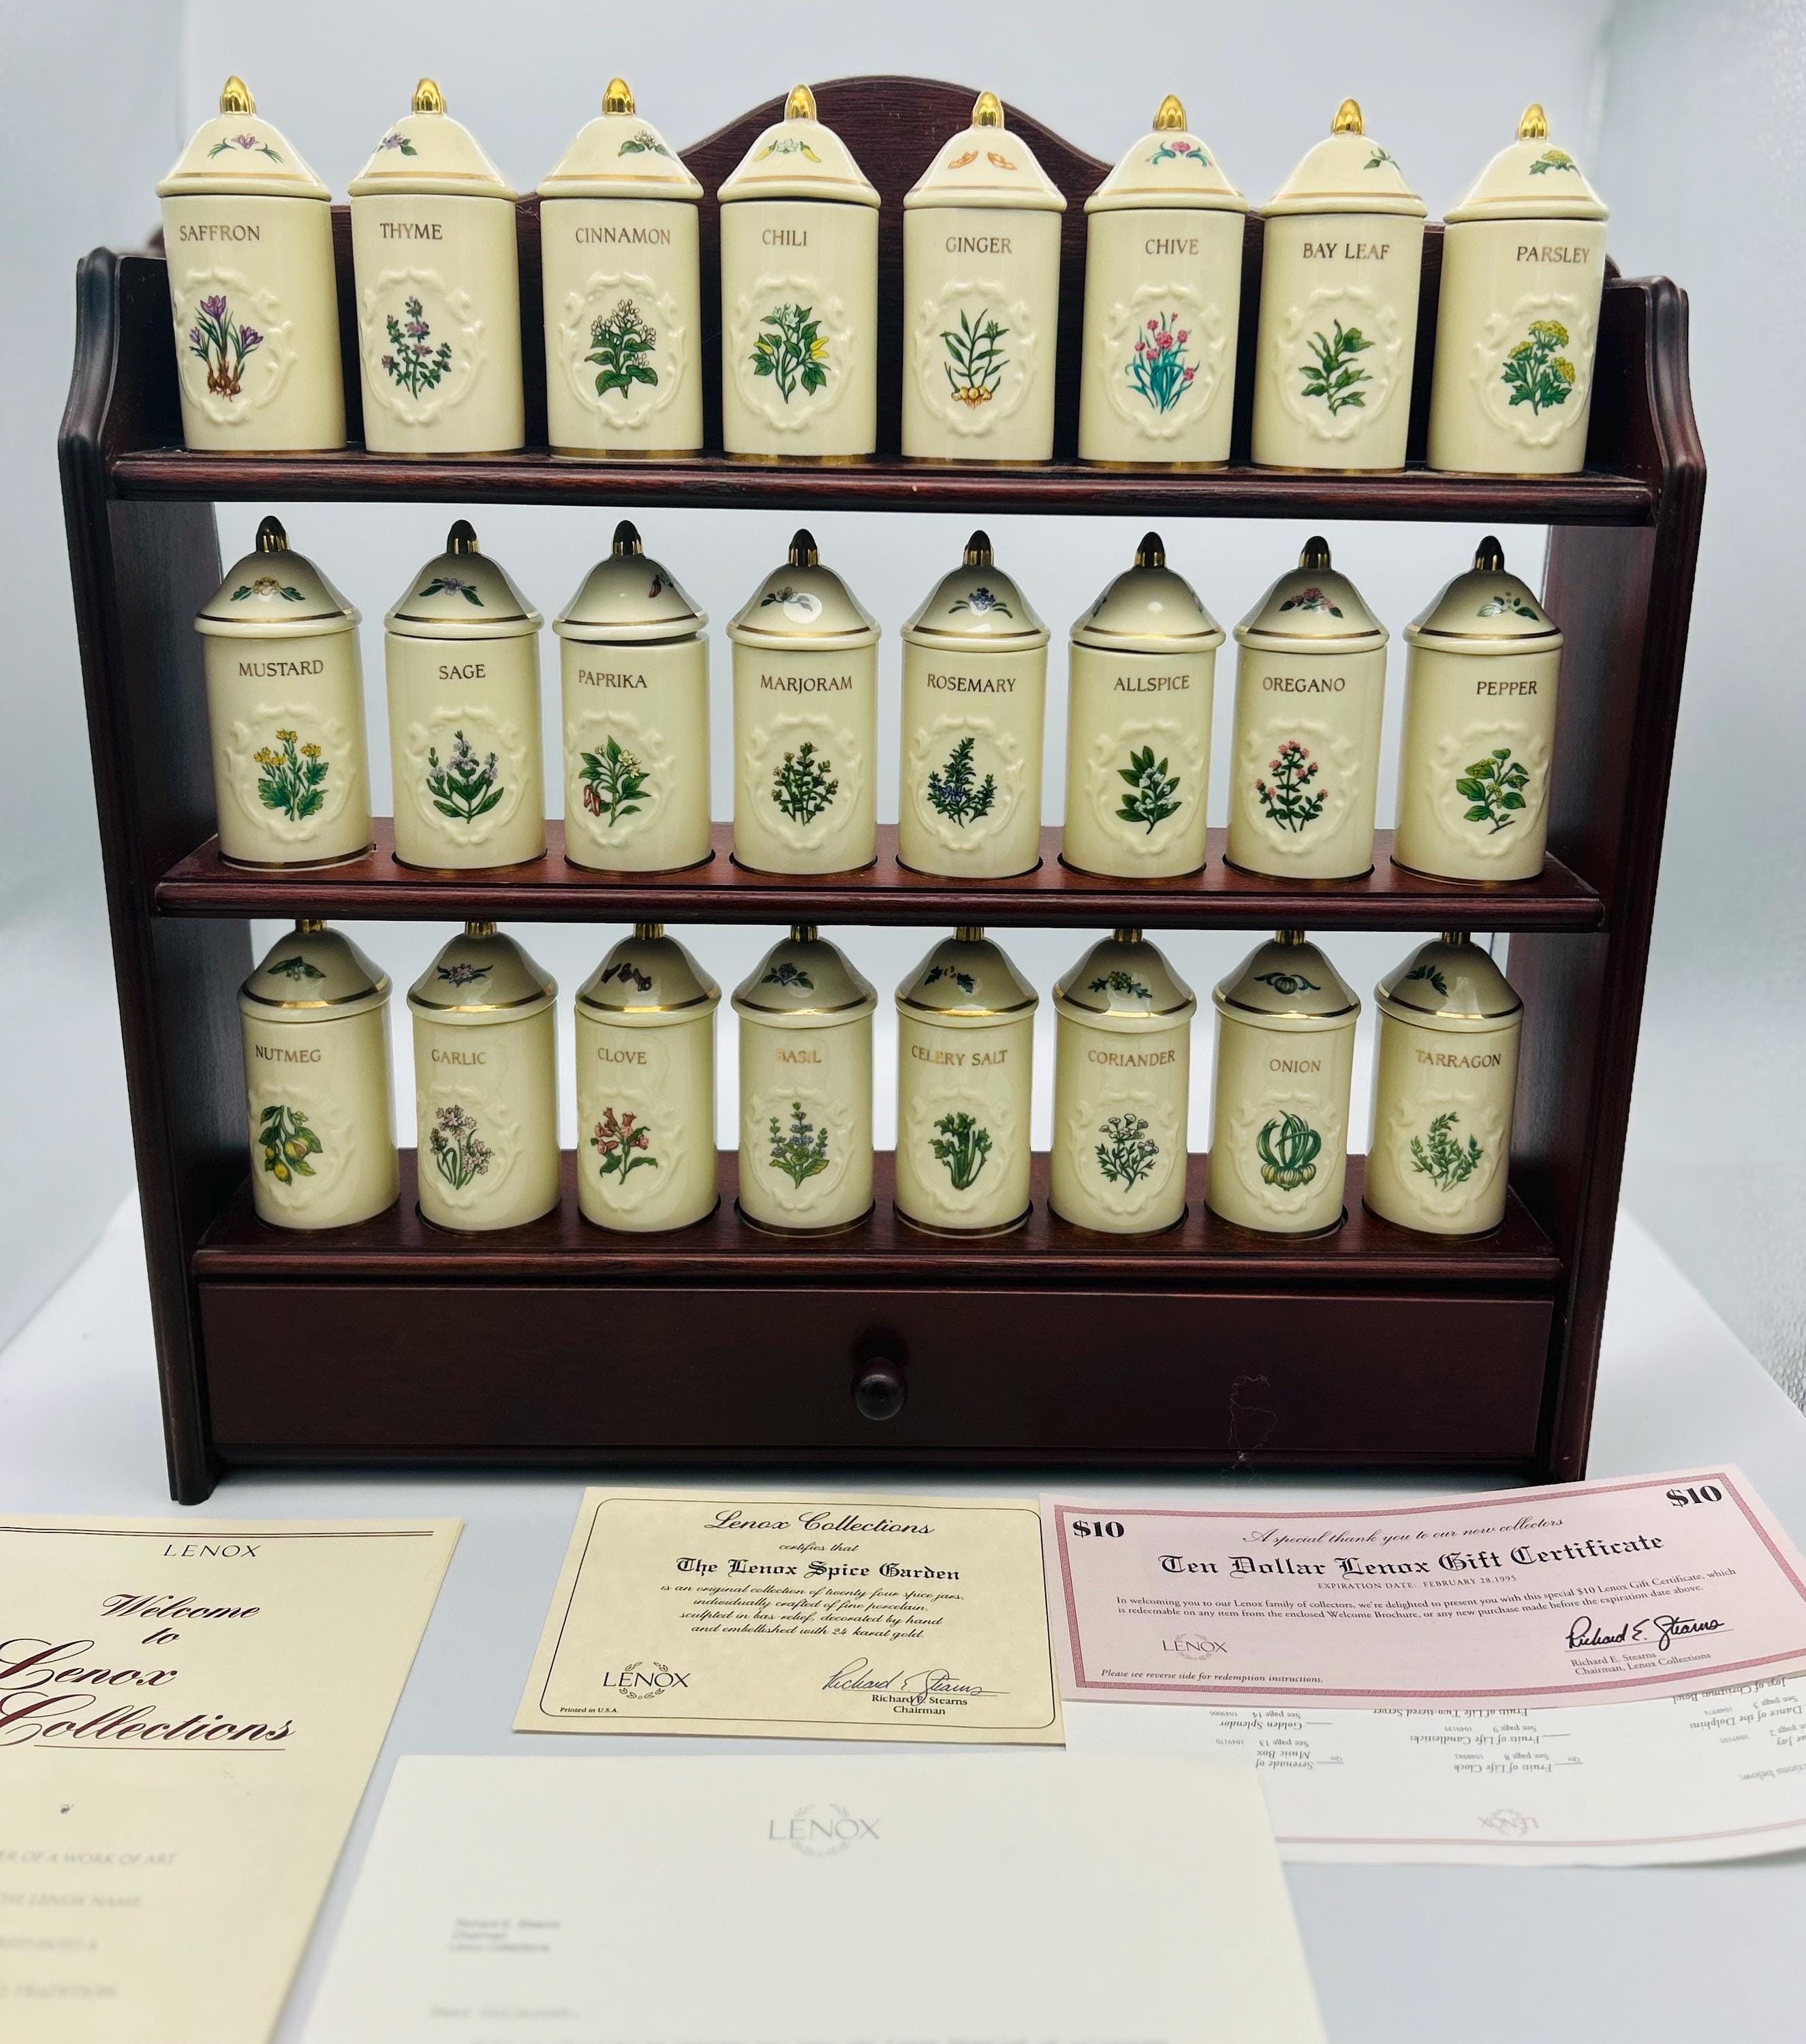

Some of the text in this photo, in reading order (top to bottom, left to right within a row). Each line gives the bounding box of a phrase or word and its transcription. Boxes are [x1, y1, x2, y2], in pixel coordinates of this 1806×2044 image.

[180, 226, 260, 241] SAFFRON
[380, 223, 442, 240] THYME
[576, 228, 670, 245] CINNAMON
[762, 230, 807, 246] CHILI
[946, 237, 1012, 253] GINGER
[1145, 238, 1198, 255] CHIVE
[1303, 243, 1389, 259] BAY LEAF
[1517, 246, 1589, 263] PARSLEY
[240, 660, 324, 677] MUSTARD
[439, 664, 486, 679] SAGE
[579, 670, 647, 688] PAPRIKA
[761, 675, 852, 694] MARJORAM
[927, 674, 1016, 692] ROSEMARY
[1114, 675, 1189, 692] ALLSPICE
[1263, 677, 1345, 692] OREGANO
[1477, 681, 1537, 696] PEPPER
[256, 1045, 321, 1063] NUTMEG
[432, 1049, 485, 1065] GARLIC
[598, 1048, 647, 1064] CLOVE
[776, 1049, 822, 1064] BASIL
[912, 1046, 1008, 1066] CELERY SALT
[1089, 1050, 1174, 1067] CORIANDER
[1416, 1051, 1501, 1068] TARRAGON
[1270, 1059, 1321, 1073] ONION
[1666, 1485, 1722, 1507] $10
[704, 1511, 935, 1533] Lenox Collections
[1072, 1520, 1125, 1538] $10
[1243, 1528, 1279, 1543] A
[1273, 1530, 1331, 1547] special
[1328, 1529, 1382, 1543] thank
[1380, 1533, 1410, 1546] you
[1416, 1531, 1429, 1540] to
[1463, 1527, 1495, 1536] new
[1499, 1516, 1563, 1532] collectors
[164, 1544, 262, 1558] LENOX
[779, 1542, 859, 1553] certifies that
[1158, 1534, 1664, 1580] Ten Dollar Lenox Gift Certificate
[676, 1558, 959, 1580] The Lenox Spice Garden
[1130, 1598, 1181, 1607] welcoming
[1265, 1600, 1294, 1609] family
[1297, 1600, 1307, 1608] of
[1309, 1600, 1356, 1609] collectors,
[1386, 1600, 1429, 1610] delighted
[1444, 1598, 1478, 1609] present
[1480, 1598, 1498, 1606] you
[1500, 1594, 1521, 1602] with
[1523, 1592, 1542, 1601] this
[1543, 1588, 1575, 1601] special
[1576, 1587, 1595, 1596] $10
[1598, 1583, 1628, 1593] Lenox
[1630, 1579, 1651, 1589] Gift
[1652, 1573, 1705, 1586] Certificate,
[1707, 1568, 1737, 1579] which
[1423, 1578, 1476, 1588] FEBRUARY
[696, 1585, 750, 1596] original
[750, 1585, 806, 1594] collection
[809, 1586, 826, 1598] of
[905, 1590, 934, 1599] spice
[101, 1594, 261, 1619] Welcome
[694, 1598, 928, 1611] individually crafted of fine porcelain,
[679, 1610, 734, 1621] sculpted
[821, 1613, 883, 1622] decorated
[886, 1615, 902, 1627] by
[905, 1615, 943, 1624] hand
[141, 1627, 181, 1645] to
[722, 1624, 798, 1633] embellished
[800, 1626, 827, 1635] with
[853, 1627, 890, 1637] karat
[1162, 1640, 1228, 1653] LENOX
[0, 1638, 178, 1690] Lenox
[1571, 1656, 1607, 1667] Richard
[1623, 1652, 1657, 1662] Stearns
[1575, 1652, 1711, 1676] Chairman, Lenox Collections
[603, 1672, 691, 1688] LENOX
[1102, 1669, 1129, 1678] Please
[1197, 1672, 1212, 1682] for
[1214, 1673, 1266, 1683] redemption
[1268, 1675, 1324, 1684] instructions.
[1701, 1685, 1751, 1698] Christmas
[1753, 1681, 1764, 1693] of
[872, 1694, 913, 1703] Richard
[929, 1696, 967, 1705] Stearns
[1672, 1692, 1698, 1705] Bowl
[893, 1705, 946, 1715] Chairman
[1690, 1705, 1803, 1730] Dance of the Dolphins
[0, 1691, 296, 1746] Collections
[1219, 1720, 1303, 1731] Golden Splendor
[1410, 1734, 1540, 1745] Fruits of Life Candlesticks
[1256, 1750, 1310, 1759] Music Box
[1255, 1759, 1313, 1770] Serenade of
[768, 1818, 880, 1840] LENOX
